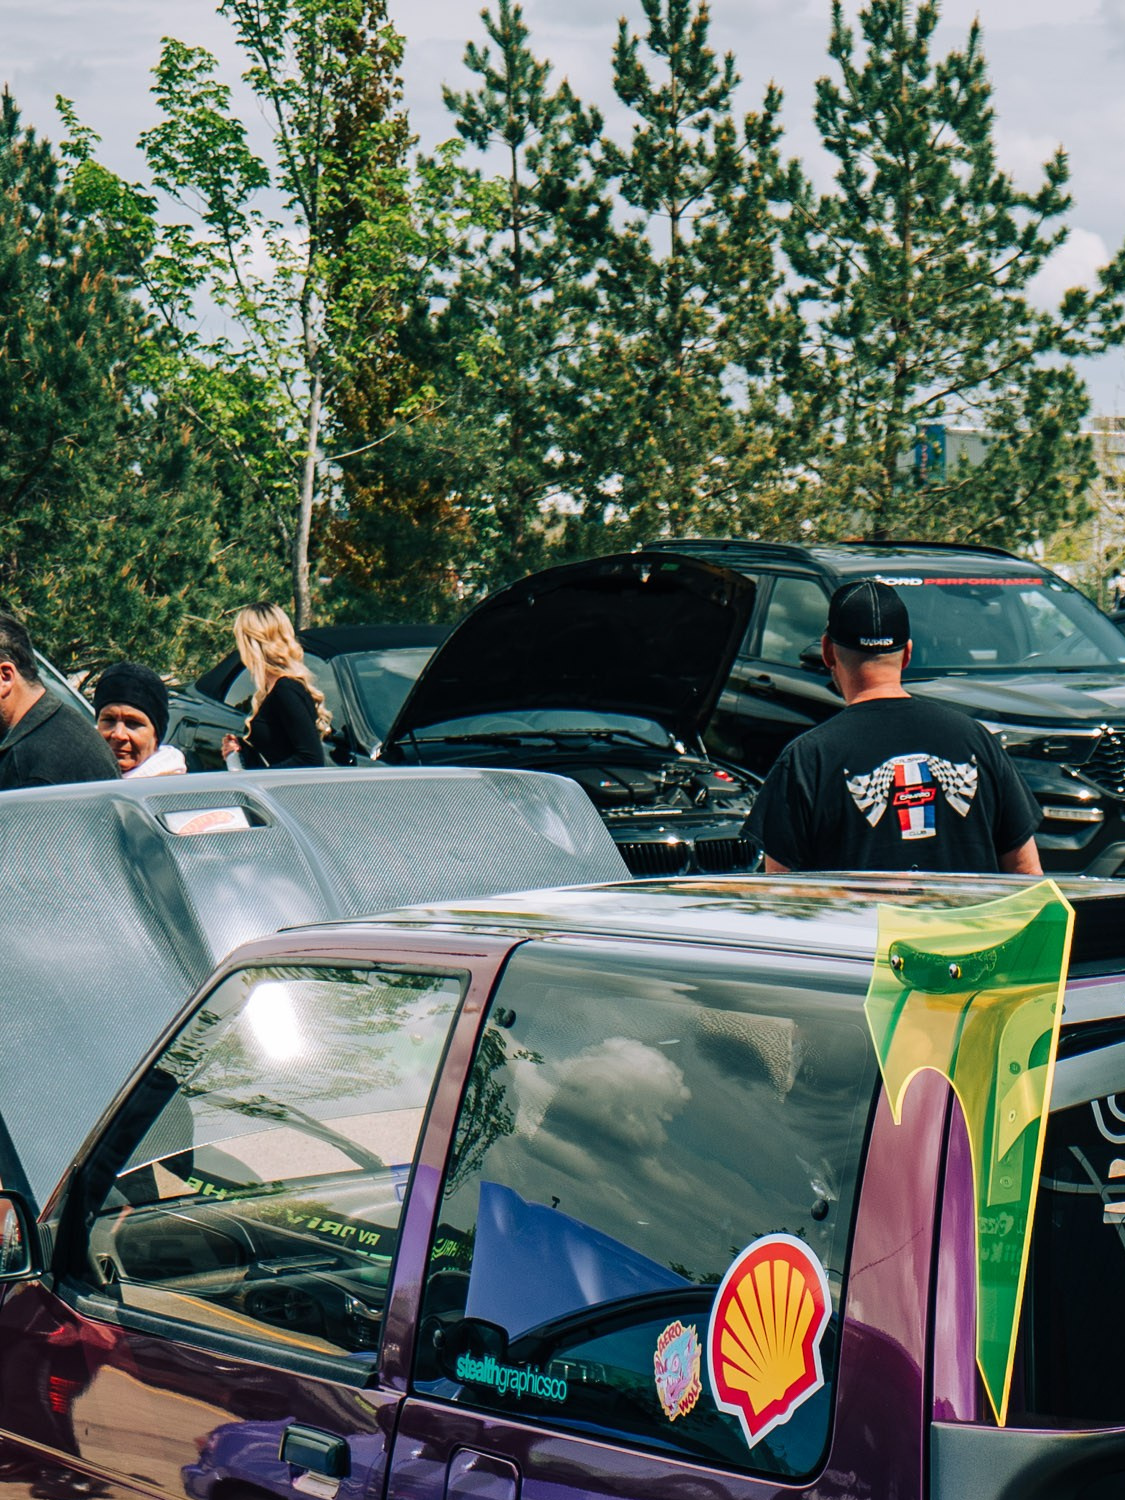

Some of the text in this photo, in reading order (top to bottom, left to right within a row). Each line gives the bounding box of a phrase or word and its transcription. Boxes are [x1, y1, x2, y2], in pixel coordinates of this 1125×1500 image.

[924, 578, 1044, 586] PERFORMANCE
[659, 1322, 682, 1354] AERO
[456, 1350, 568, 1401] stealthgraphicsco
